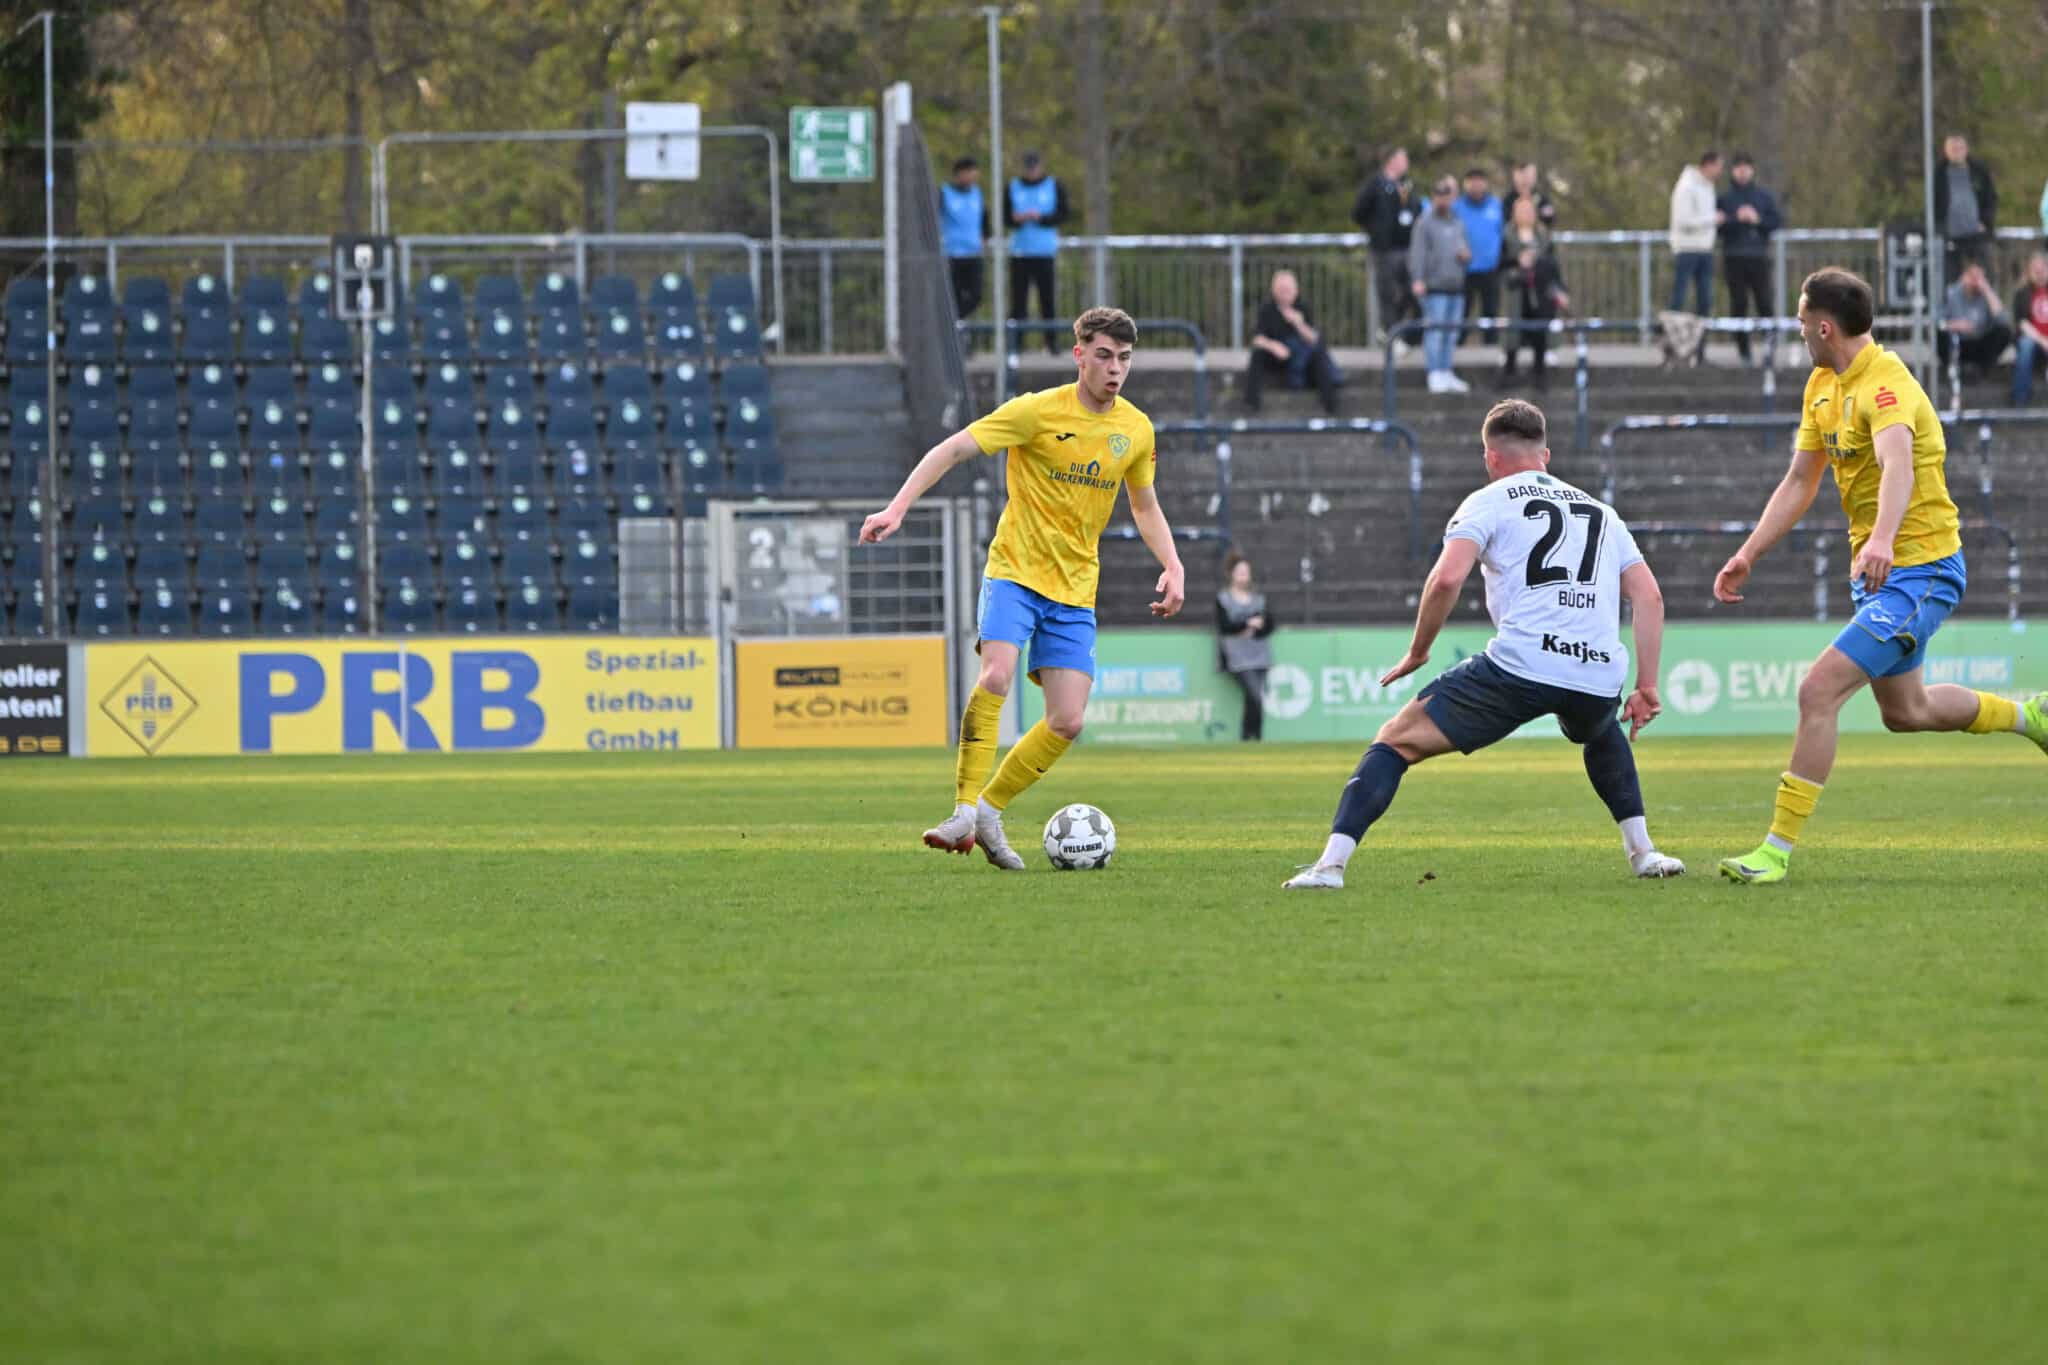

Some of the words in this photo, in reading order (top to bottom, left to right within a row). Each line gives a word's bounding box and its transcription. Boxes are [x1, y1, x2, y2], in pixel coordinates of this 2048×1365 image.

[1070, 462, 1086, 474] DIE
[1507, 485, 1592, 502] BABELSBER
[1523, 499, 1608, 589] 27
[1558, 589, 1596, 609] BÜCH
[1541, 632, 1611, 663] Katjes
[585, 649, 705, 675] Spezial-
[0, 663, 61, 688] oller
[1322, 666, 1414, 704] EWP
[239, 650, 546, 752] PRB
[585, 690, 693, 713] tiefbau
[773, 694, 909, 718] KÖNIG
[586, 729, 680, 751] GmbH
